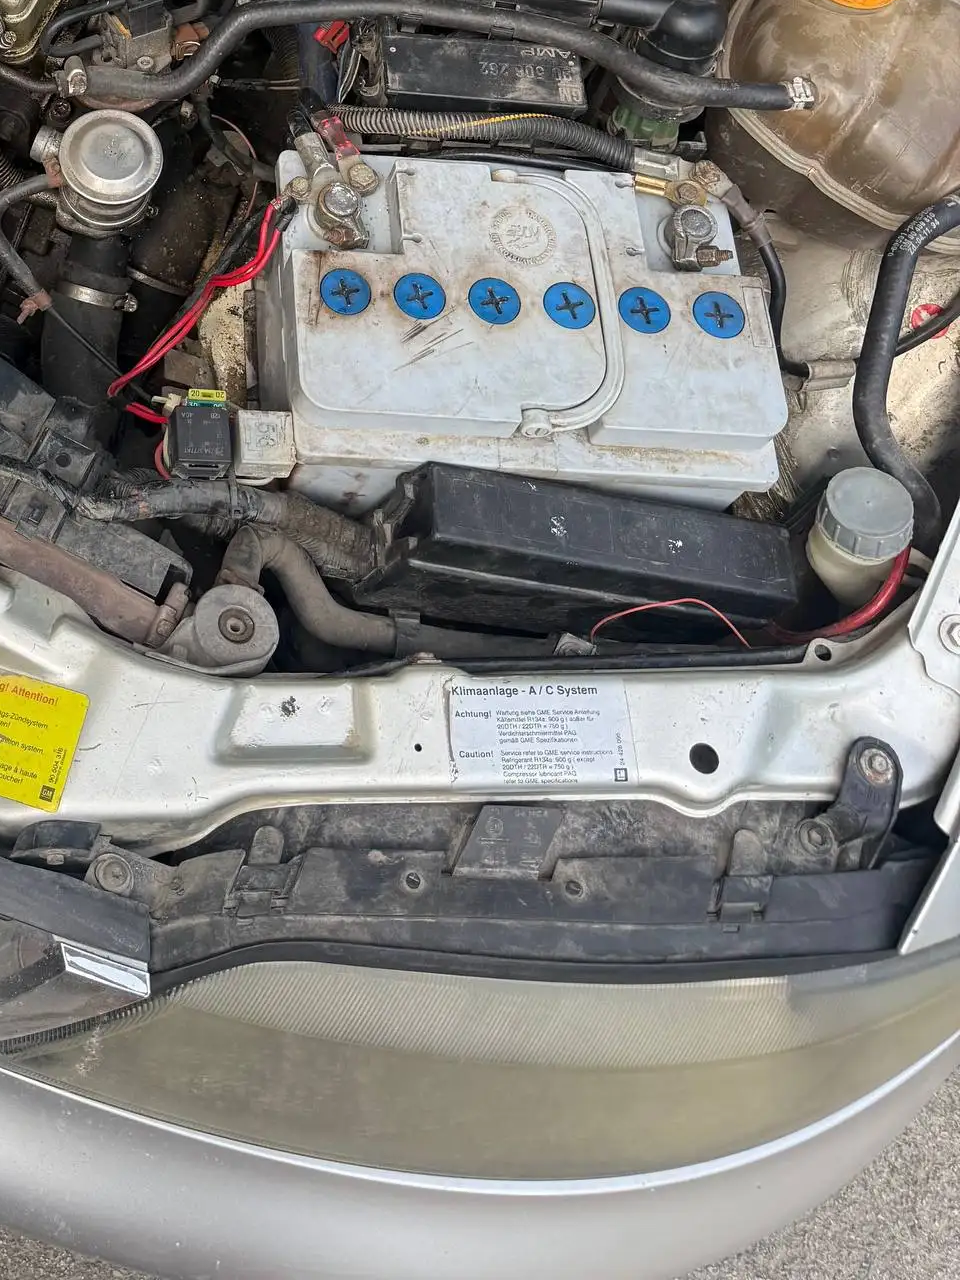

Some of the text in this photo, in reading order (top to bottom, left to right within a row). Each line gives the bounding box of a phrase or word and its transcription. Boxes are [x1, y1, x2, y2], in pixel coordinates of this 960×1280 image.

[191, 389, 200, 398] 20
[216, 390, 225, 399] 20
[10, 685, 58, 706] Attention!
[452, 686, 518, 697] Klimaanlage
[529, 686, 536, 695] A
[546, 686, 554, 695] C
[557, 685, 598, 697] System
[455, 710, 491, 719] Achtung!
[459, 750, 494, 758] Caution!
